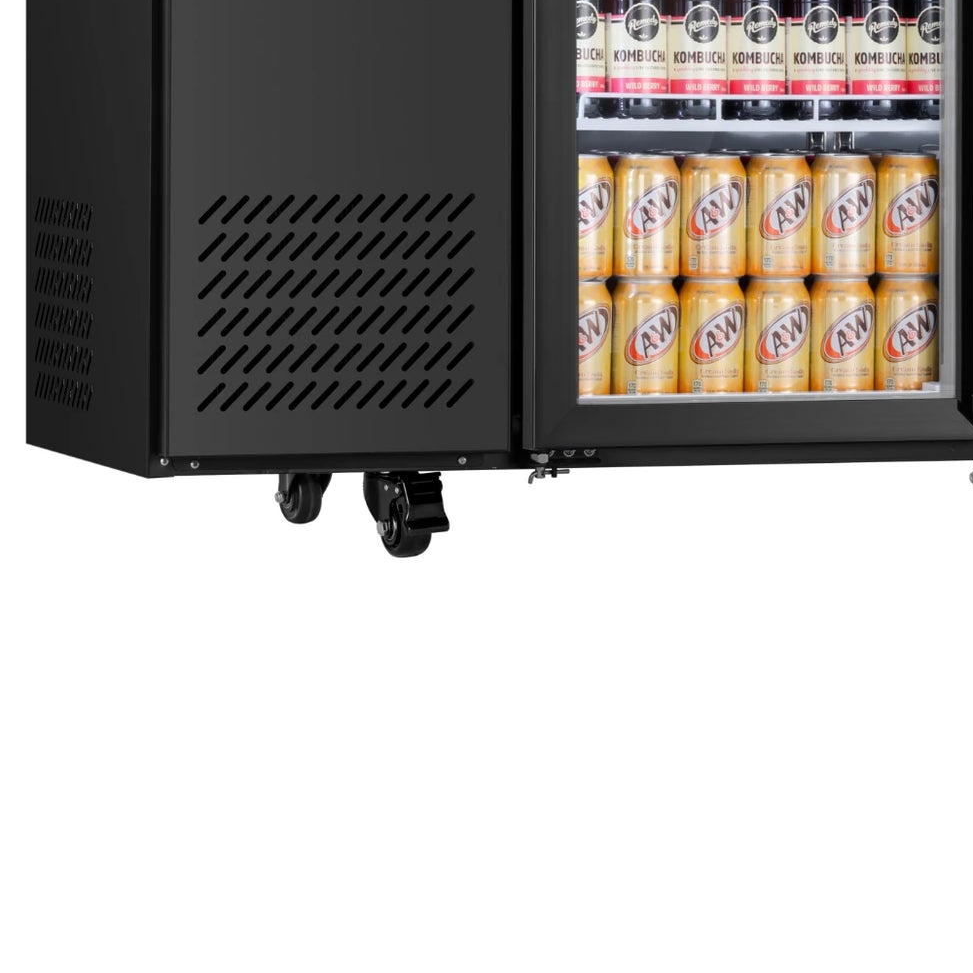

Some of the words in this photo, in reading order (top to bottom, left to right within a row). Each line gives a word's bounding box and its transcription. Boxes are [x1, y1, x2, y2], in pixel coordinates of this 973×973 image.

[628, 15, 659, 34] Remedy
[688, 16, 719, 35] Remedy
[746, 17, 776, 36] Remedy
[808, 17, 838, 37] Remedy
[868, 18, 898, 37] Remedy
[854, 52, 906, 65] KOMBUCHA
[626, 82, 642, 90] WILD
[686, 83, 702, 91] WILD
[806, 84, 822, 92] WILD
[866, 84, 882, 92] WILD
